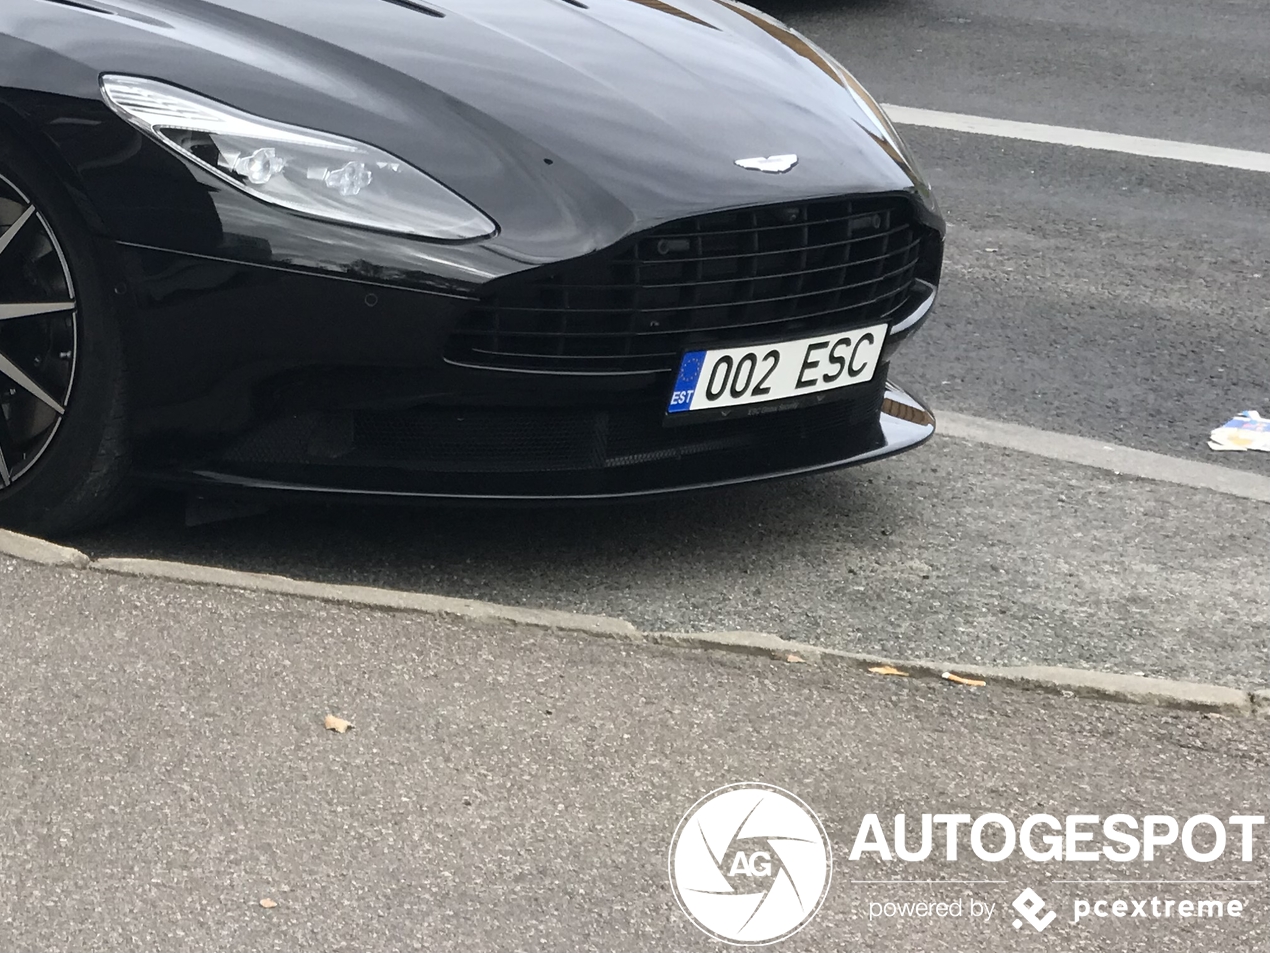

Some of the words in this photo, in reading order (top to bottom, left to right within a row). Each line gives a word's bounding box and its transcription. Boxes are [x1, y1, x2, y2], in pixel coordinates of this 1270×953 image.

[705, 349, 780, 402] 002
[795, 332, 874, 390] ESC
[670, 390, 694, 405] EST
